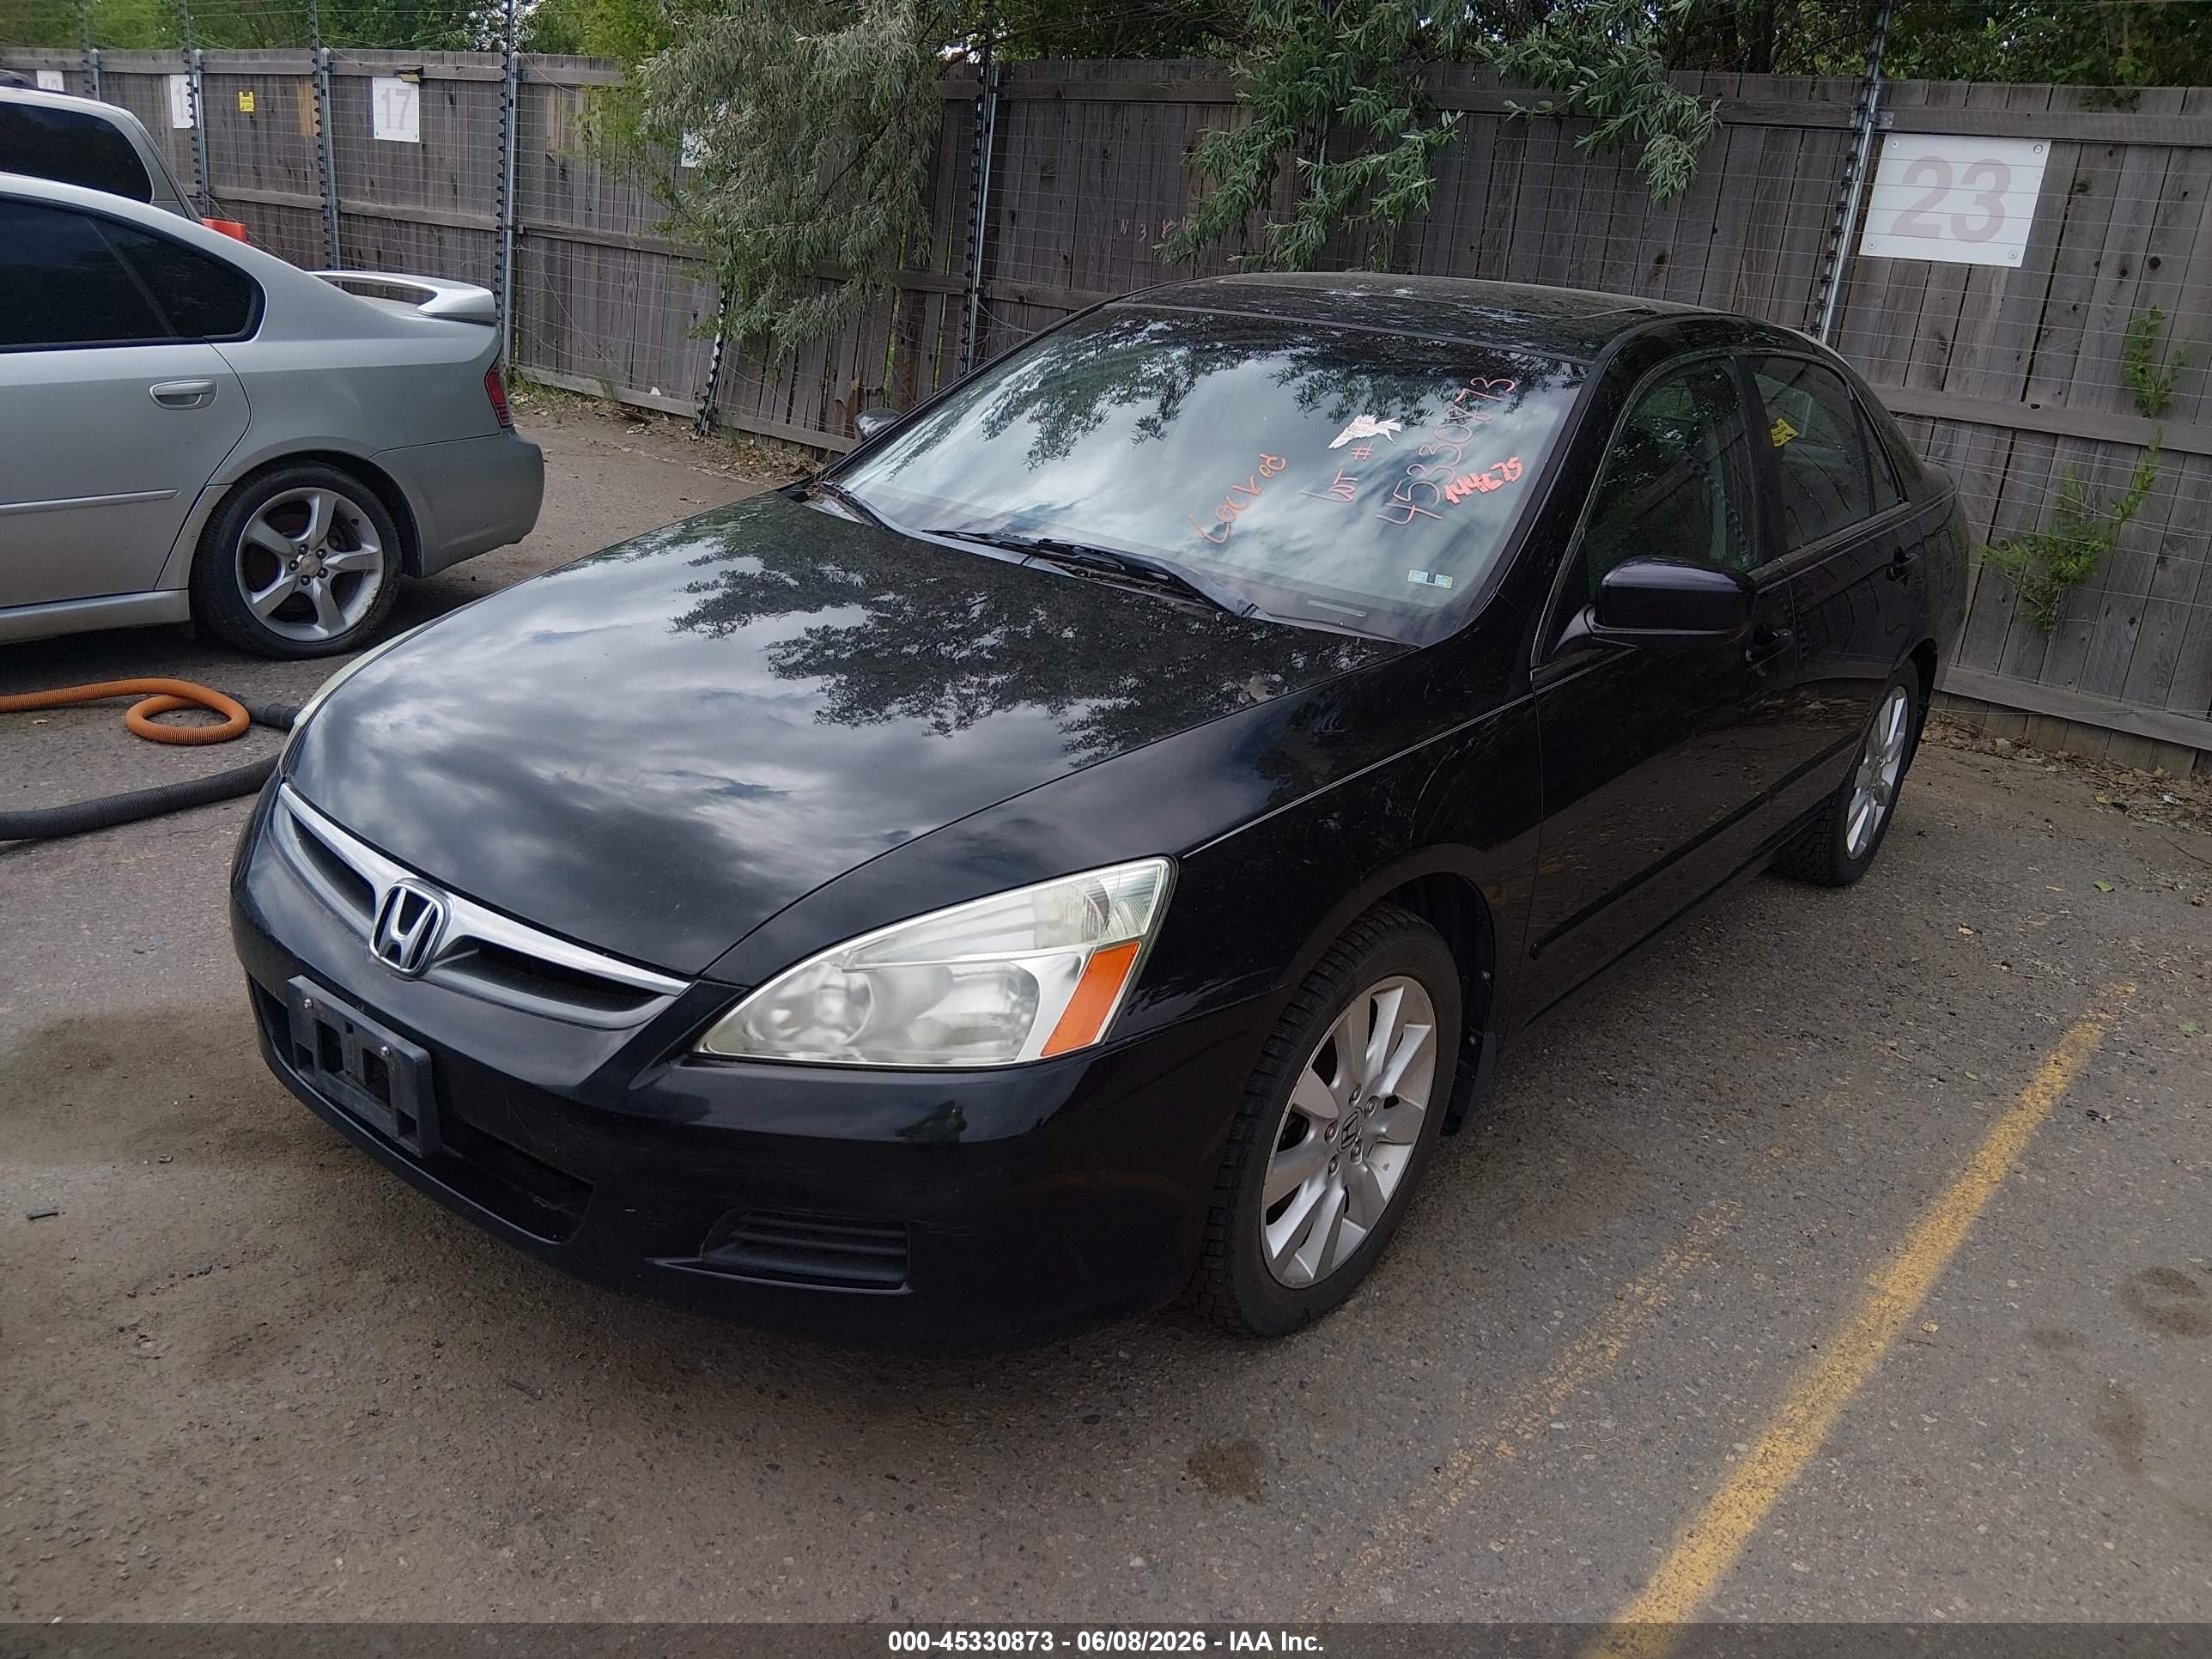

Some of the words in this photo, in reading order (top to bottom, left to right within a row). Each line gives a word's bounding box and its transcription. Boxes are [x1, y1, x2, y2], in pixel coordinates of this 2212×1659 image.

[381, 88, 412, 131] 17
[1889, 155, 2012, 244] 23
[1350, 441, 1374, 461] #
[1376, 377, 1516, 526] 45330873
